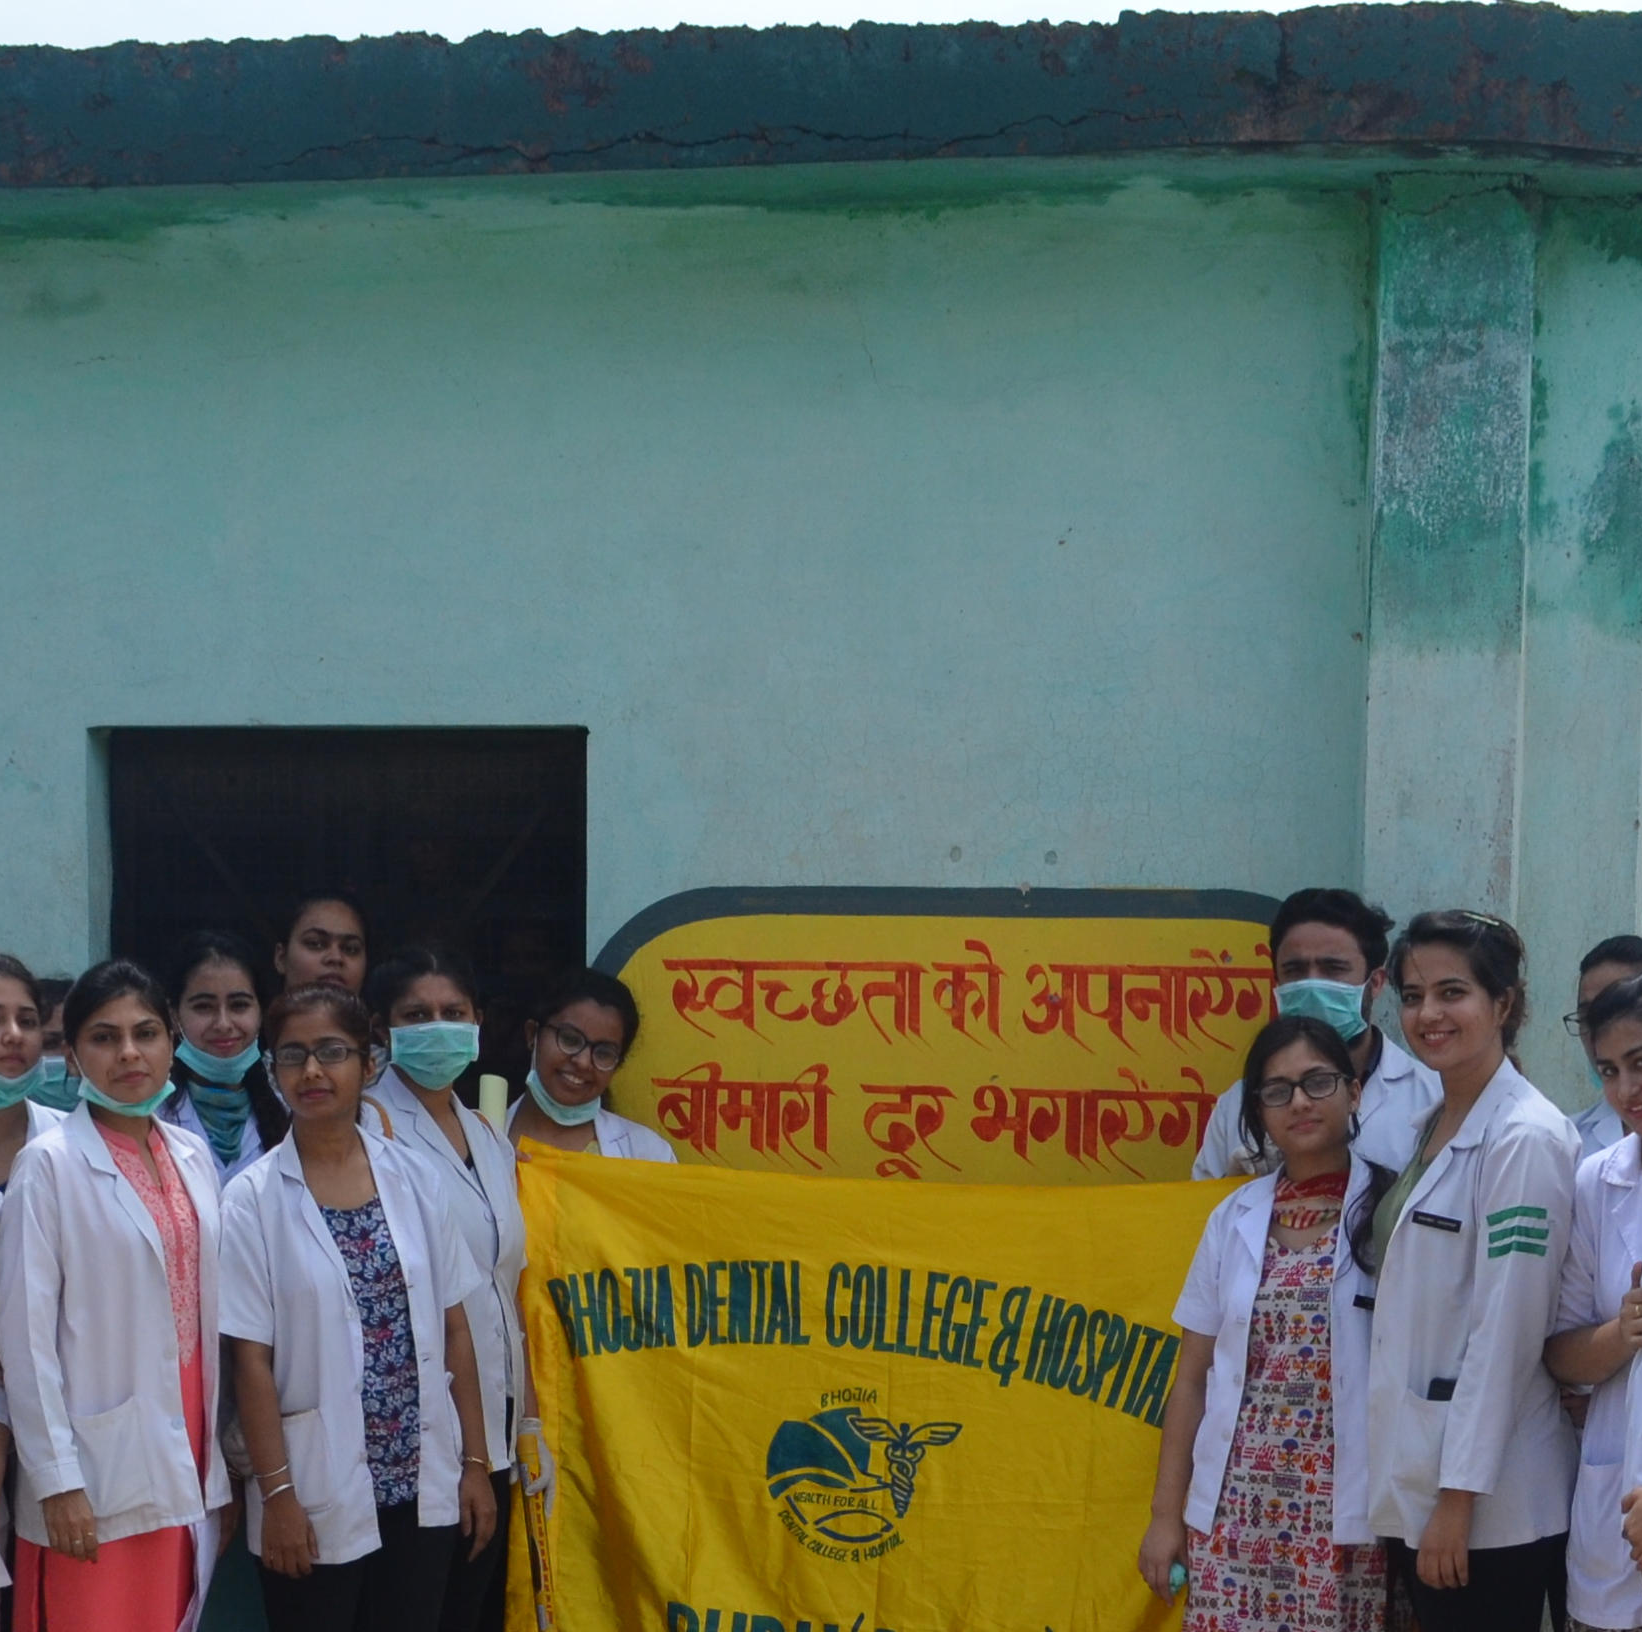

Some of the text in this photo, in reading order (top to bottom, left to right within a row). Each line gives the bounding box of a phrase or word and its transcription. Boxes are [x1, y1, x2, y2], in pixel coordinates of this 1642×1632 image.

[662, 958, 933, 1052] स्वच्छता
[932, 939, 1017, 1053] को
[651, 1061, 839, 1171] बीमारी
[860, 1082, 961, 1180] दूर
[684, 1260, 810, 1348] DENTAL
[825, 1262, 998, 1369] COLLEGE
[988, 1285, 1031, 1387] &
[1022, 1294, 1182, 1430] HOSPITA
[820, 1387, 878, 1408] BHOJIA
[777, 1509, 809, 1545] DENTAL
[793, 1491, 878, 1511] HEALTH FOR ALL
